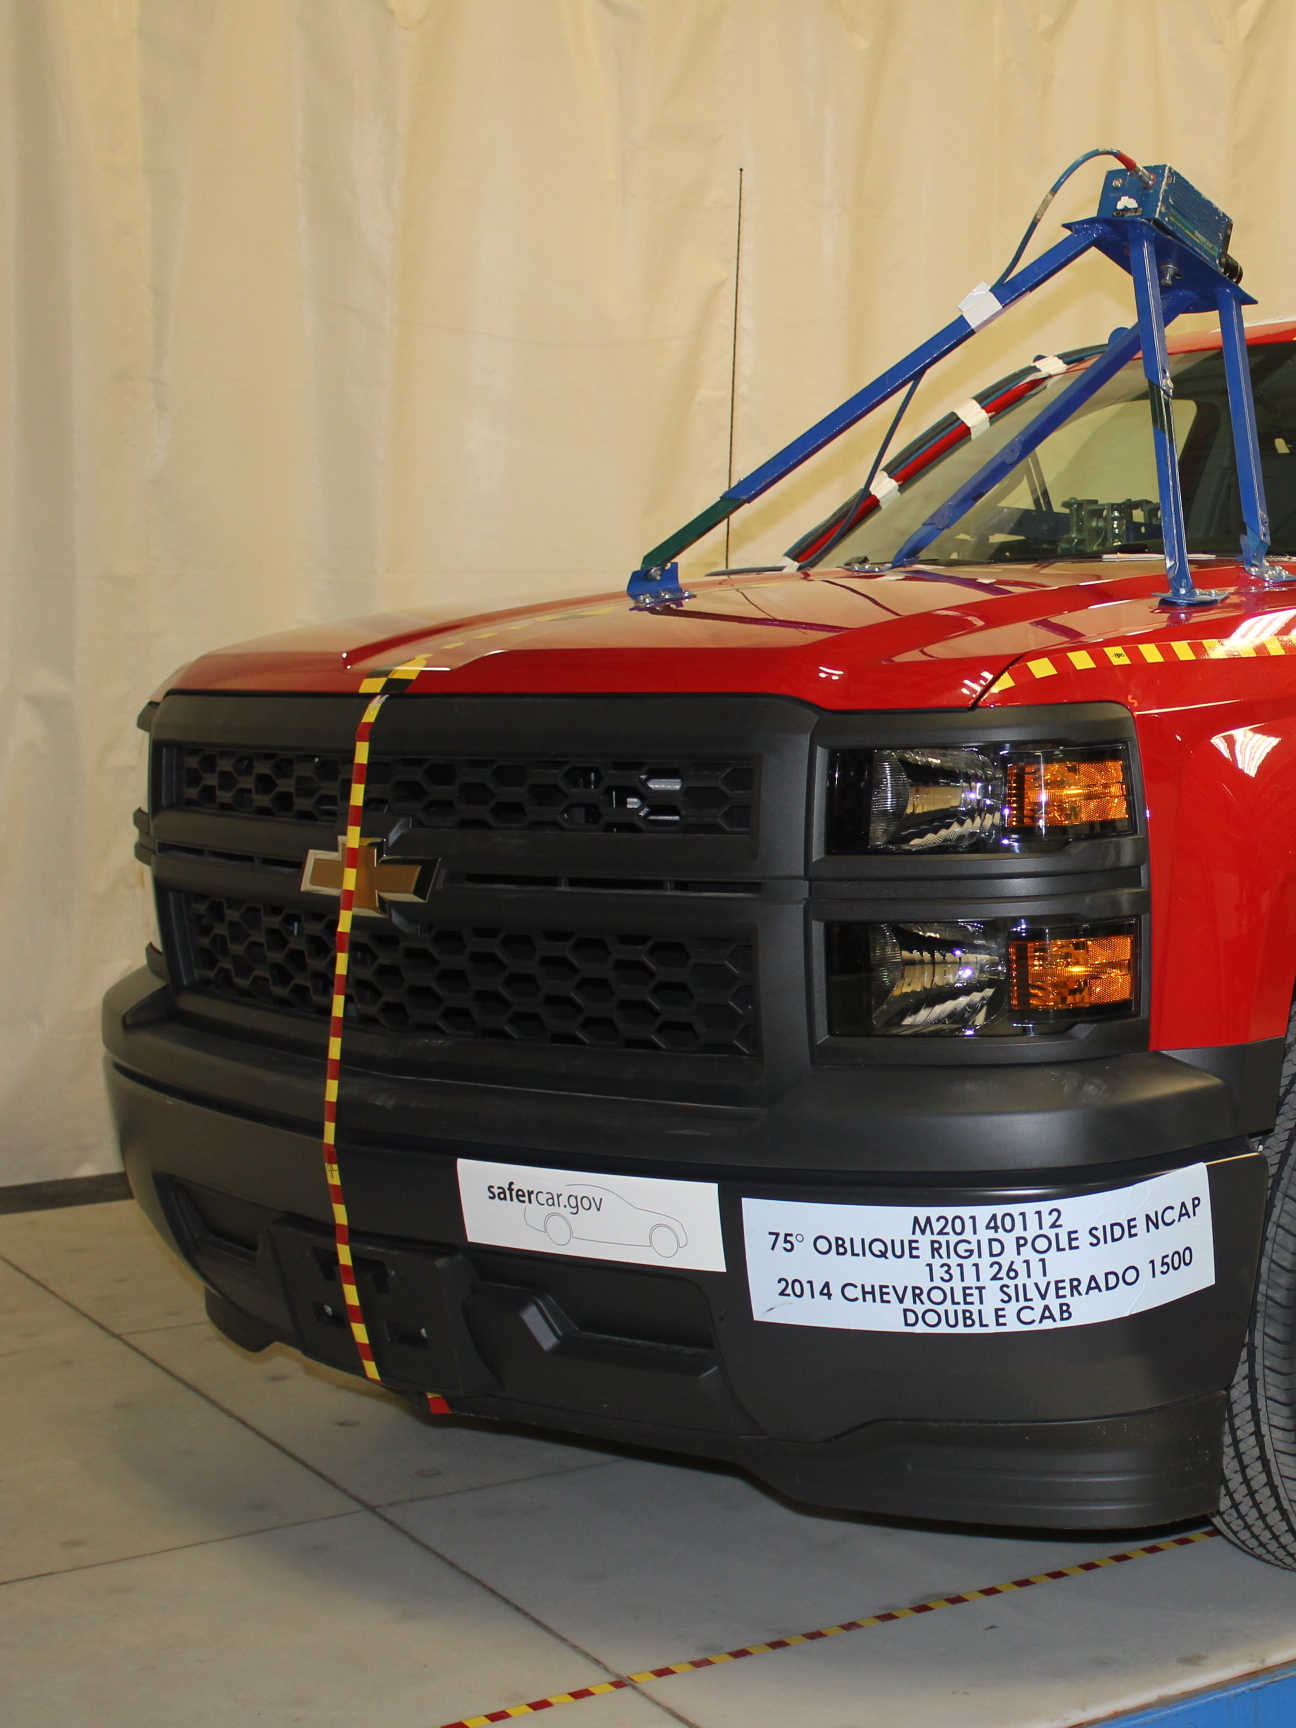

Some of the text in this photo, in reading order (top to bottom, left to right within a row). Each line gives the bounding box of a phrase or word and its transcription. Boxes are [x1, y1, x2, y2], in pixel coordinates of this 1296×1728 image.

[487, 1181, 602, 1215] safercar.gov
[768, 1196, 1202, 1261] 75° OBLIQUE RIGID POLE SIDE NCAP
[911, 1208, 1064, 1236] M20140112
[776, 1246, 1194, 1306] 2014 CHEVROLET SILVERADO 1500
[924, 1258, 1049, 1284] 13112611
[902, 1303, 1074, 1329] DOUBLE CAB
